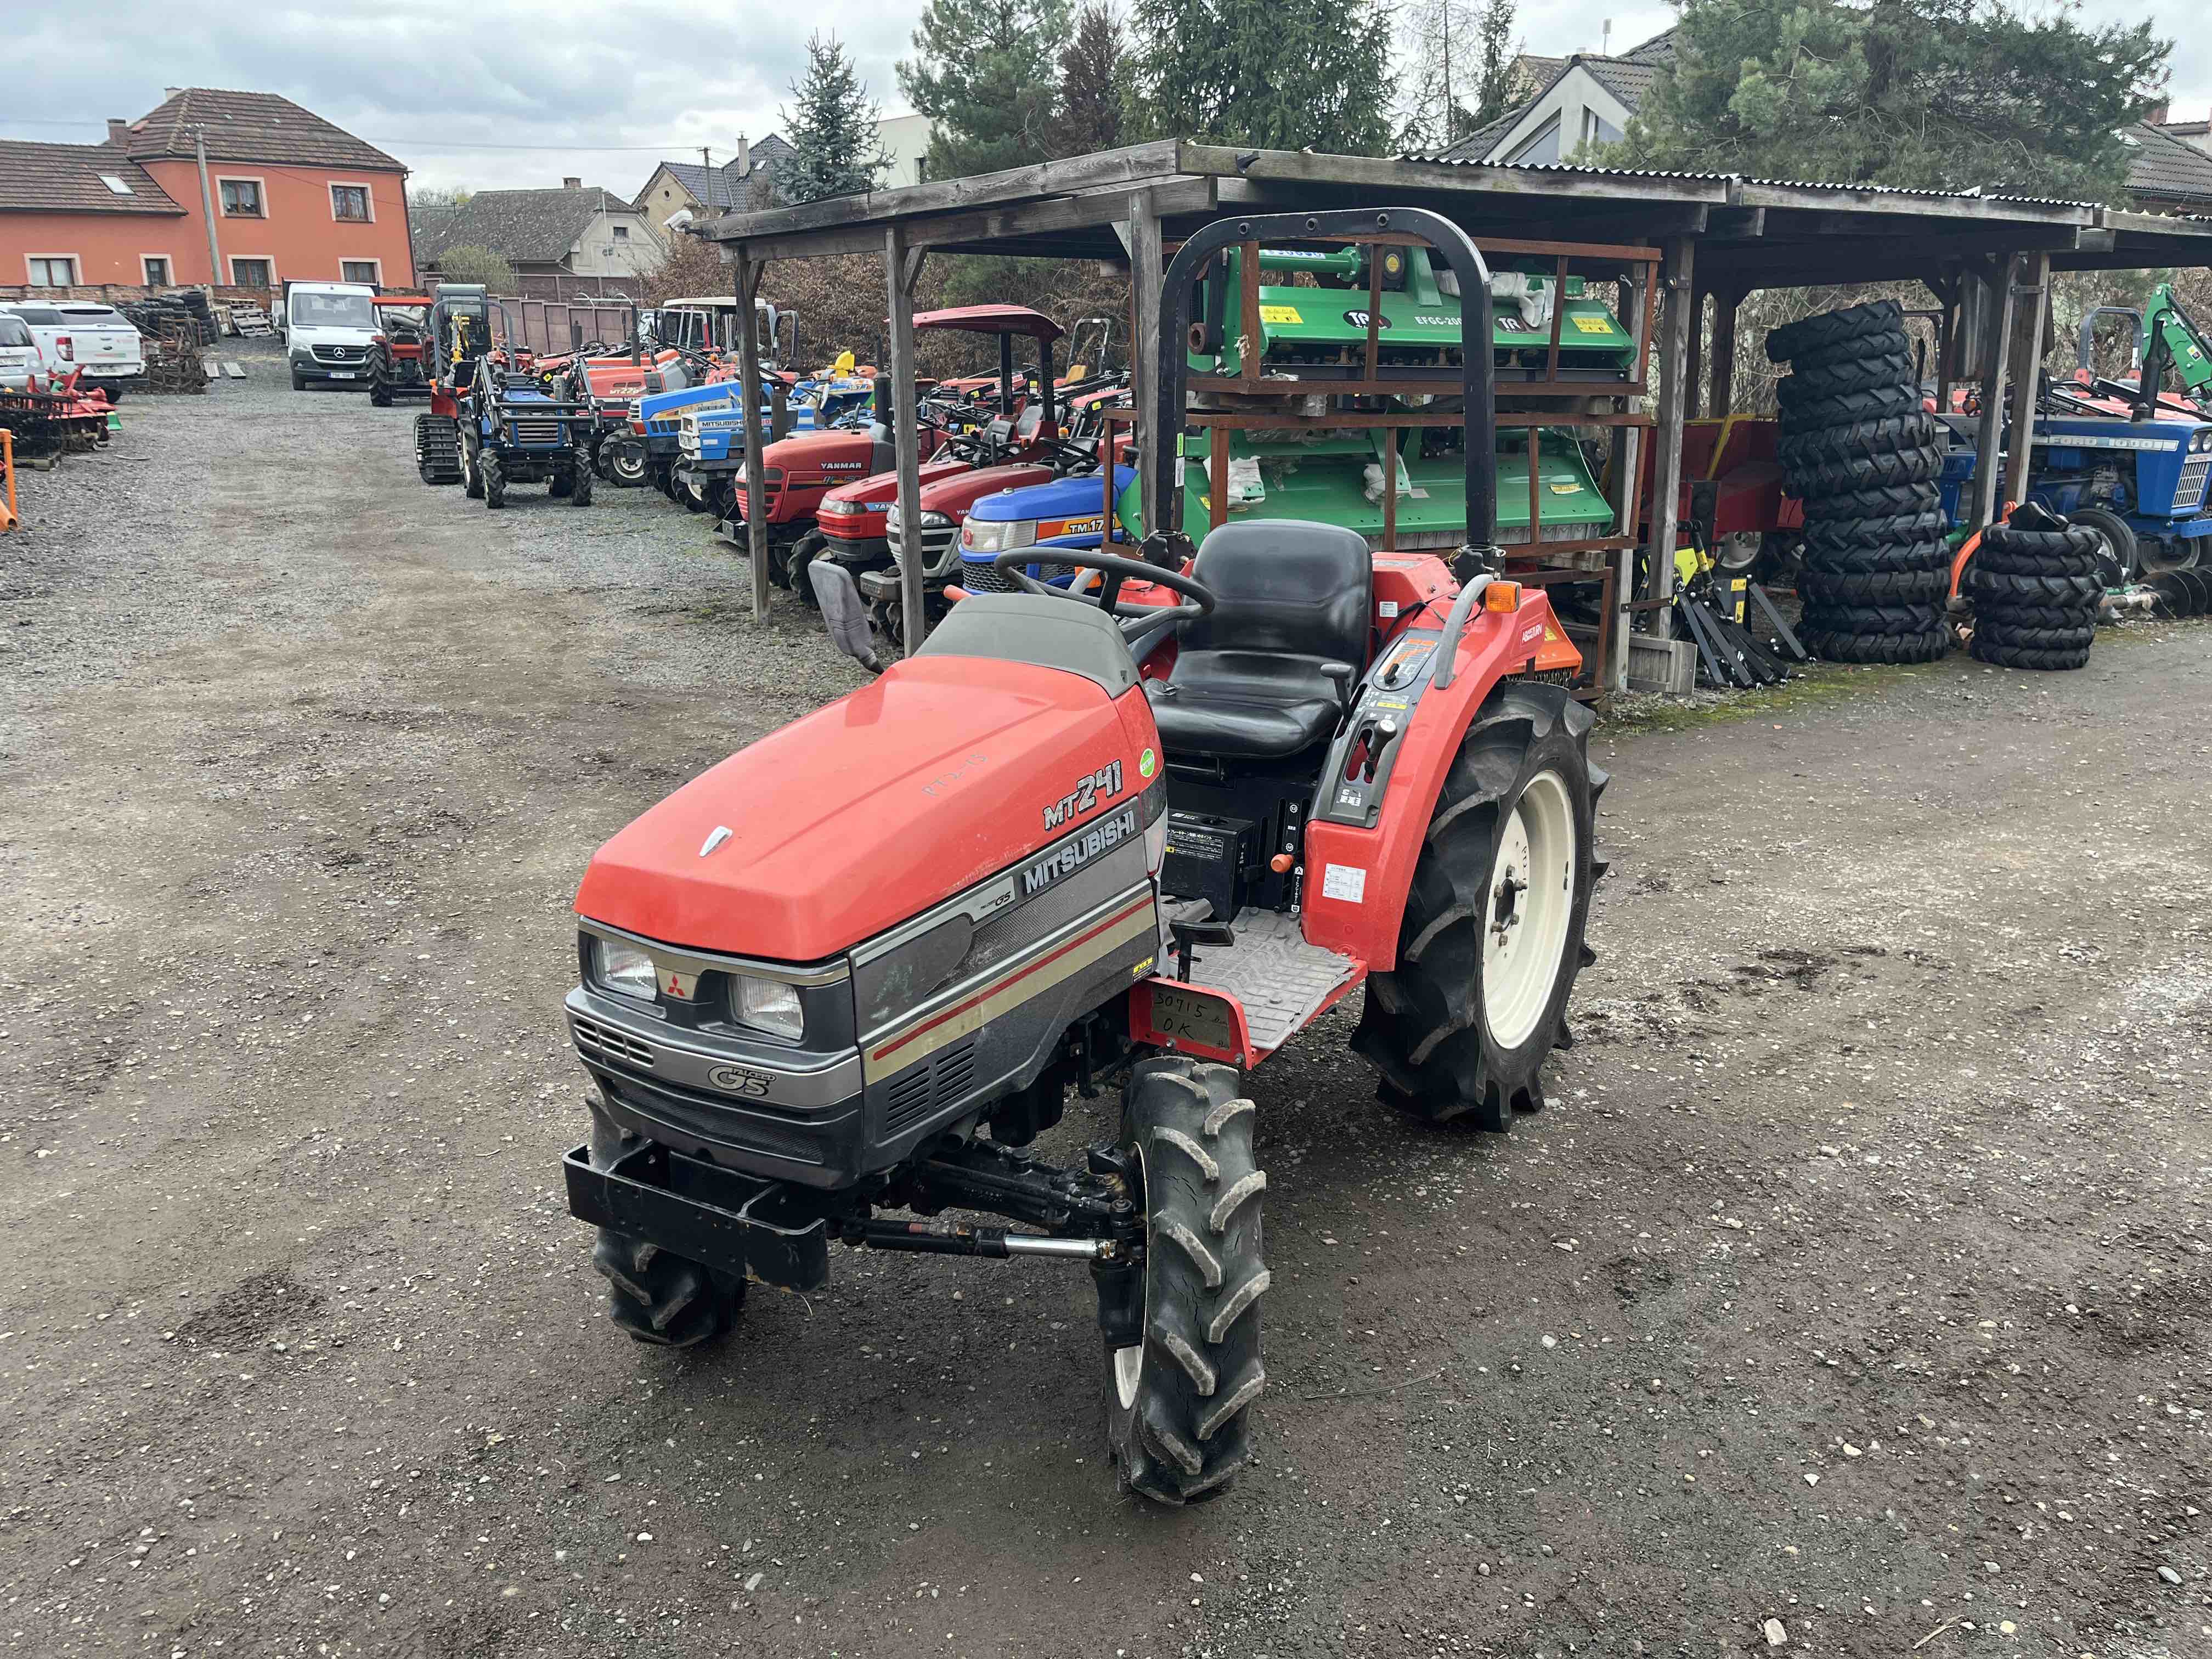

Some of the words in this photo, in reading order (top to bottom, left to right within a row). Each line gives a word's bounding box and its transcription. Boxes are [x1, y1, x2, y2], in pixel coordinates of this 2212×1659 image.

[1043, 759, 1123, 831] MT241
[1023, 810, 1136, 894] MITSUBISHI
[708, 1065, 769, 1096] GS
